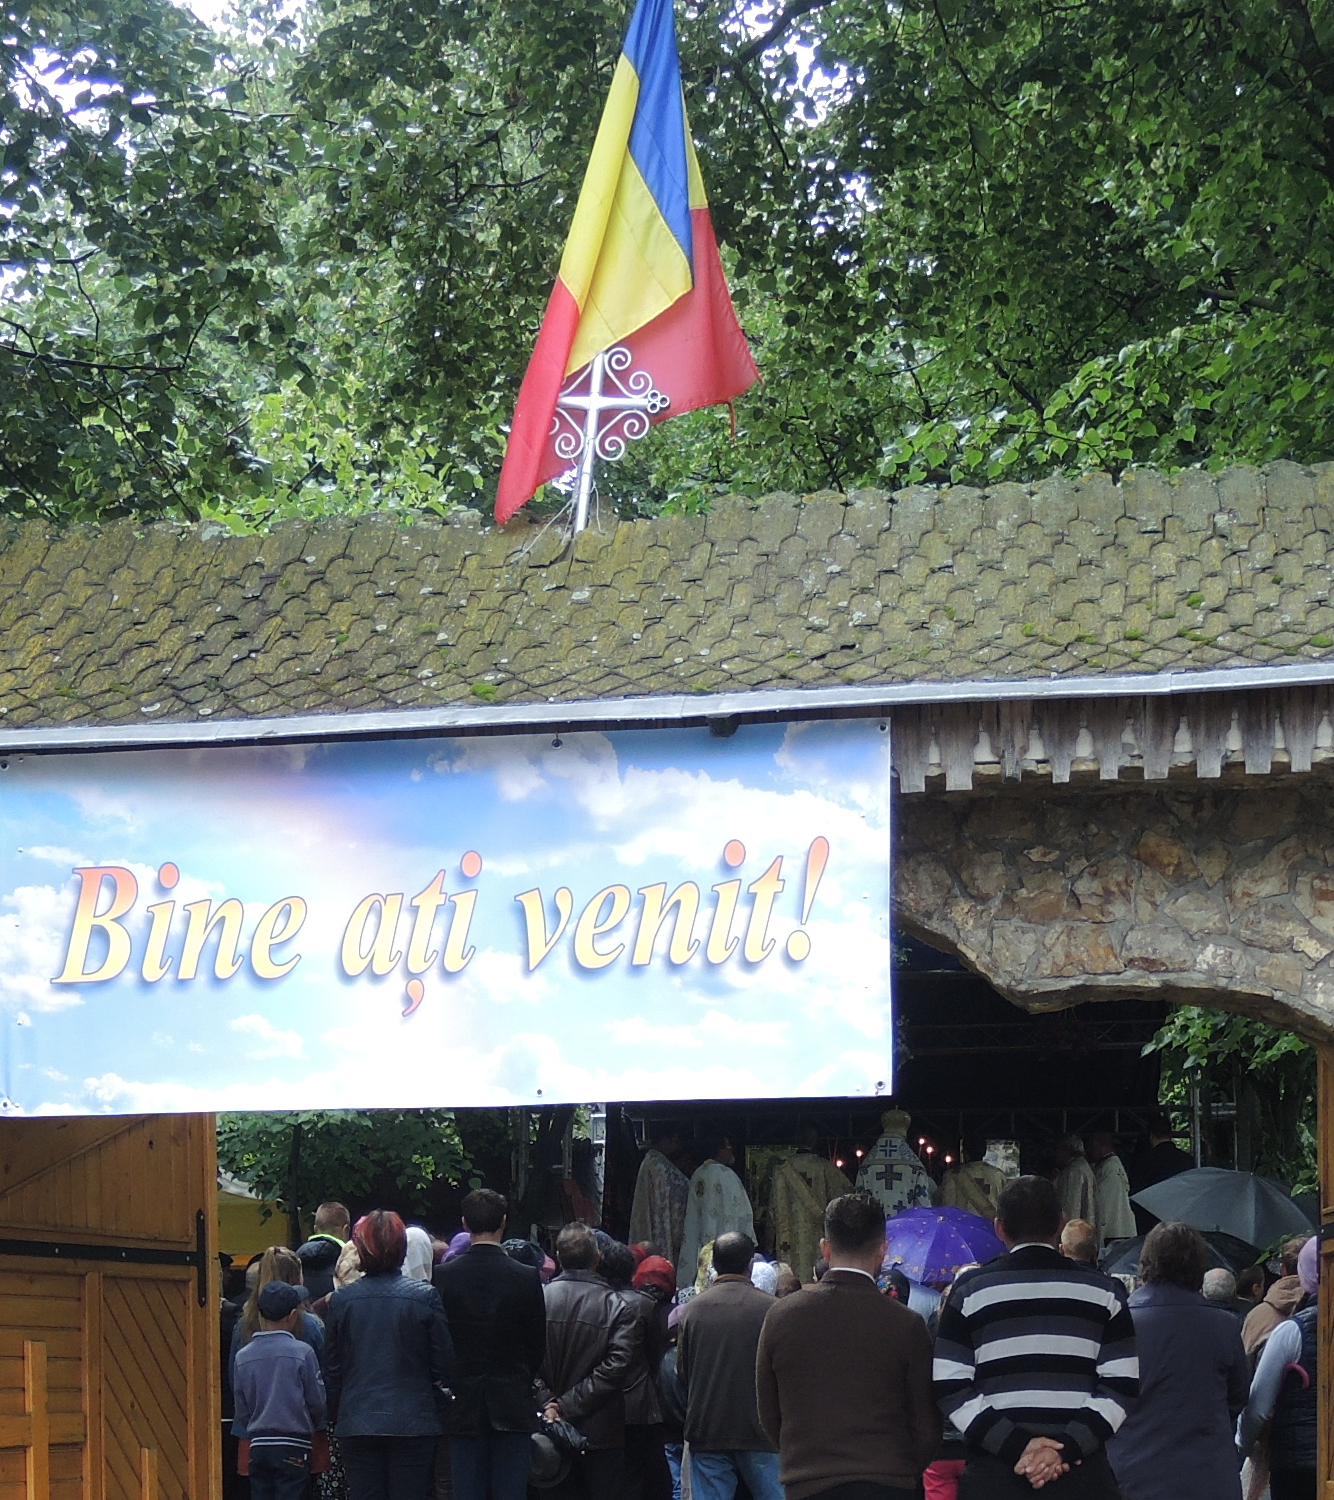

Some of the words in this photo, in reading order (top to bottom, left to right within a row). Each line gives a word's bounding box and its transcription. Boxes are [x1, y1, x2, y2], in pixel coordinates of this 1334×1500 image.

[50, 861, 308, 985] Bine
[340, 850, 483, 1017] ați
[513, 835, 831, 973] venit!
